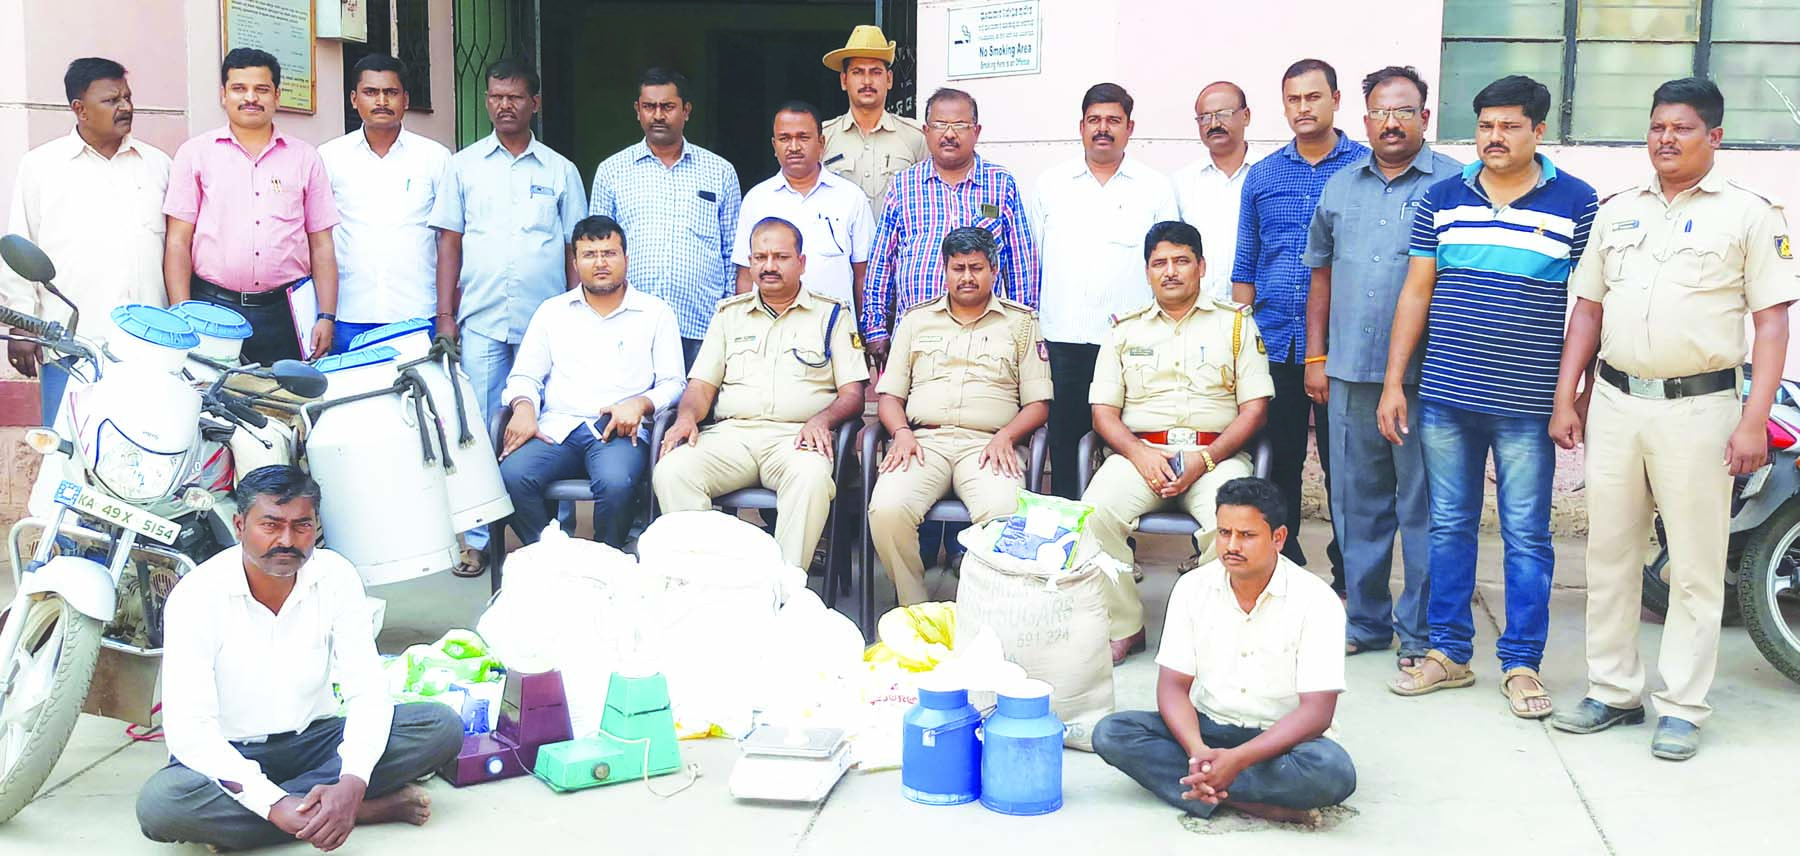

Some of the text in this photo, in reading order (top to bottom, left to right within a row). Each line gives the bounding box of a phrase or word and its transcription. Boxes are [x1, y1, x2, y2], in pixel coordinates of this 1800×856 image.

[979, 42, 1032, 58] No Smoking Area
[78, 494, 95, 509] KA
[143, 520, 174, 540] 5154
